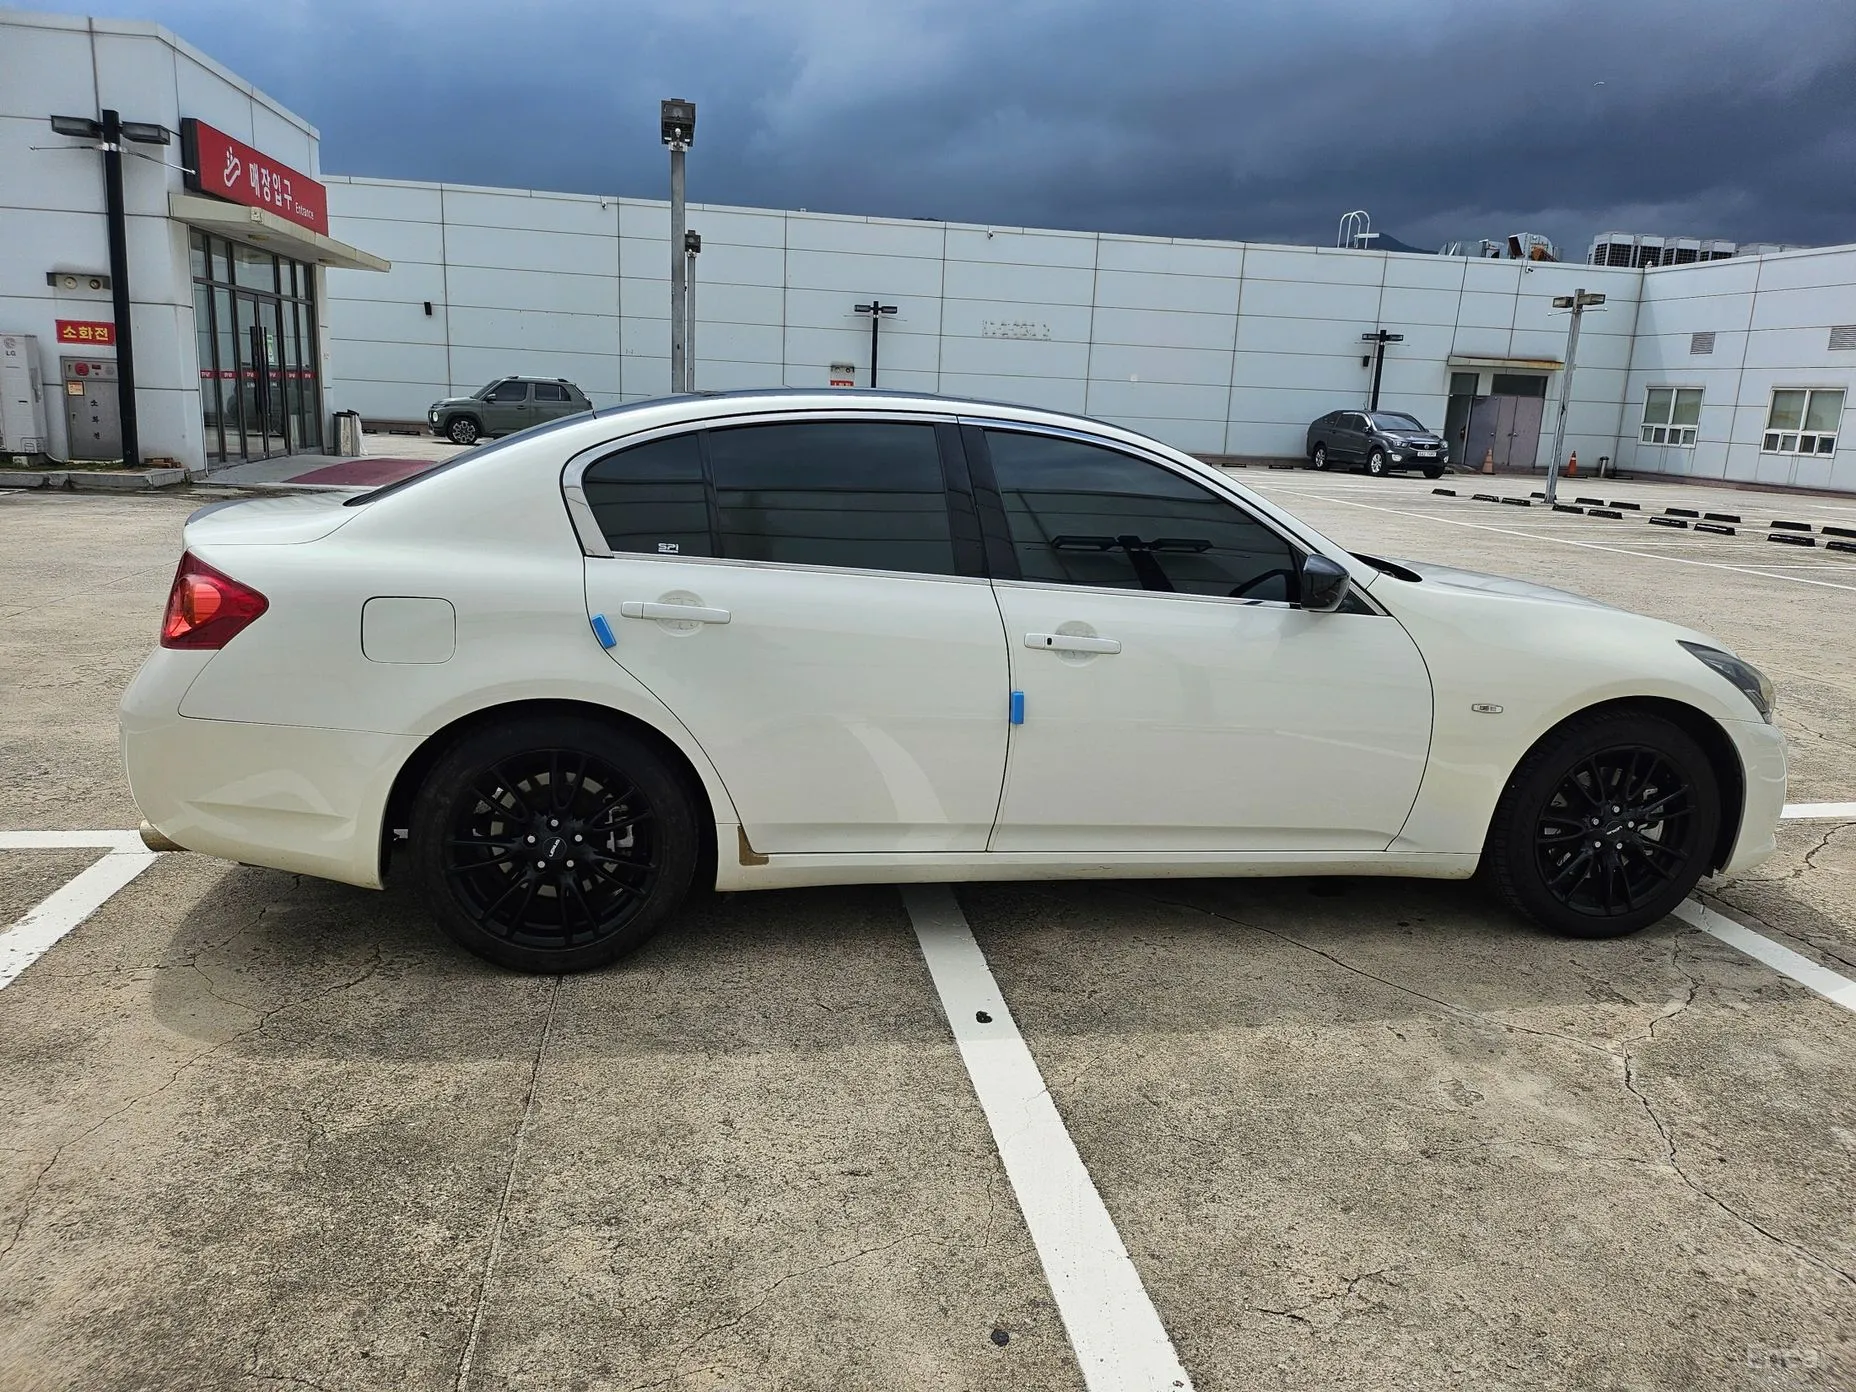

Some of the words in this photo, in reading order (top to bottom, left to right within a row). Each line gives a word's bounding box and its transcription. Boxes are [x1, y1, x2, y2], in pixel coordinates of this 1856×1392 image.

[248, 162, 293, 211] 매장입구
[295, 202, 314, 220] Entrance
[63, 325, 109, 341] 소화전
